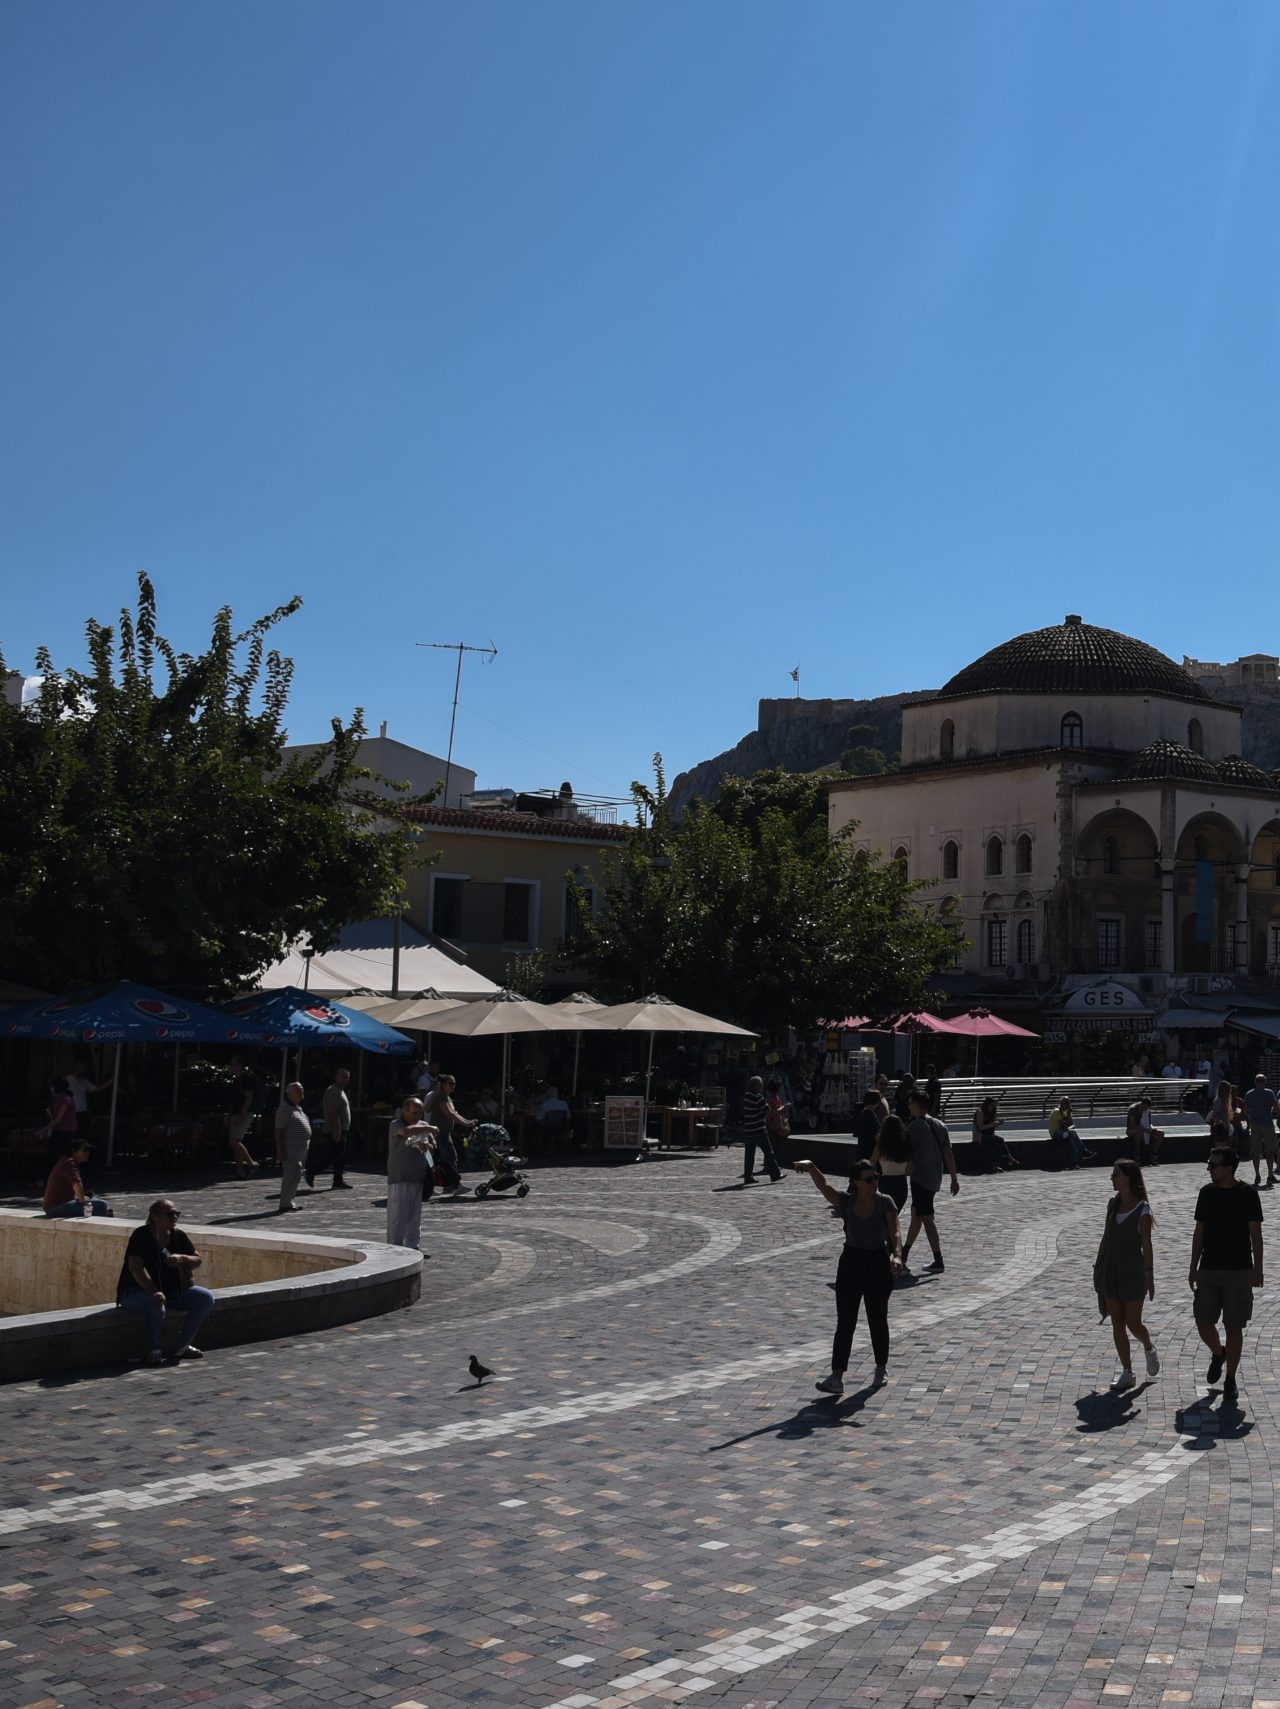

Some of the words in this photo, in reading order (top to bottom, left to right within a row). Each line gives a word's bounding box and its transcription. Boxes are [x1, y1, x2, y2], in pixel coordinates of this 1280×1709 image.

[1084, 991, 1124, 1006] GES
[97, 1030, 125, 1040] pepsi
[170, 1029, 195, 1039] pepsi
[239, 1030, 262, 1040] pepsi
[275, 1034, 298, 1044] pepsi
